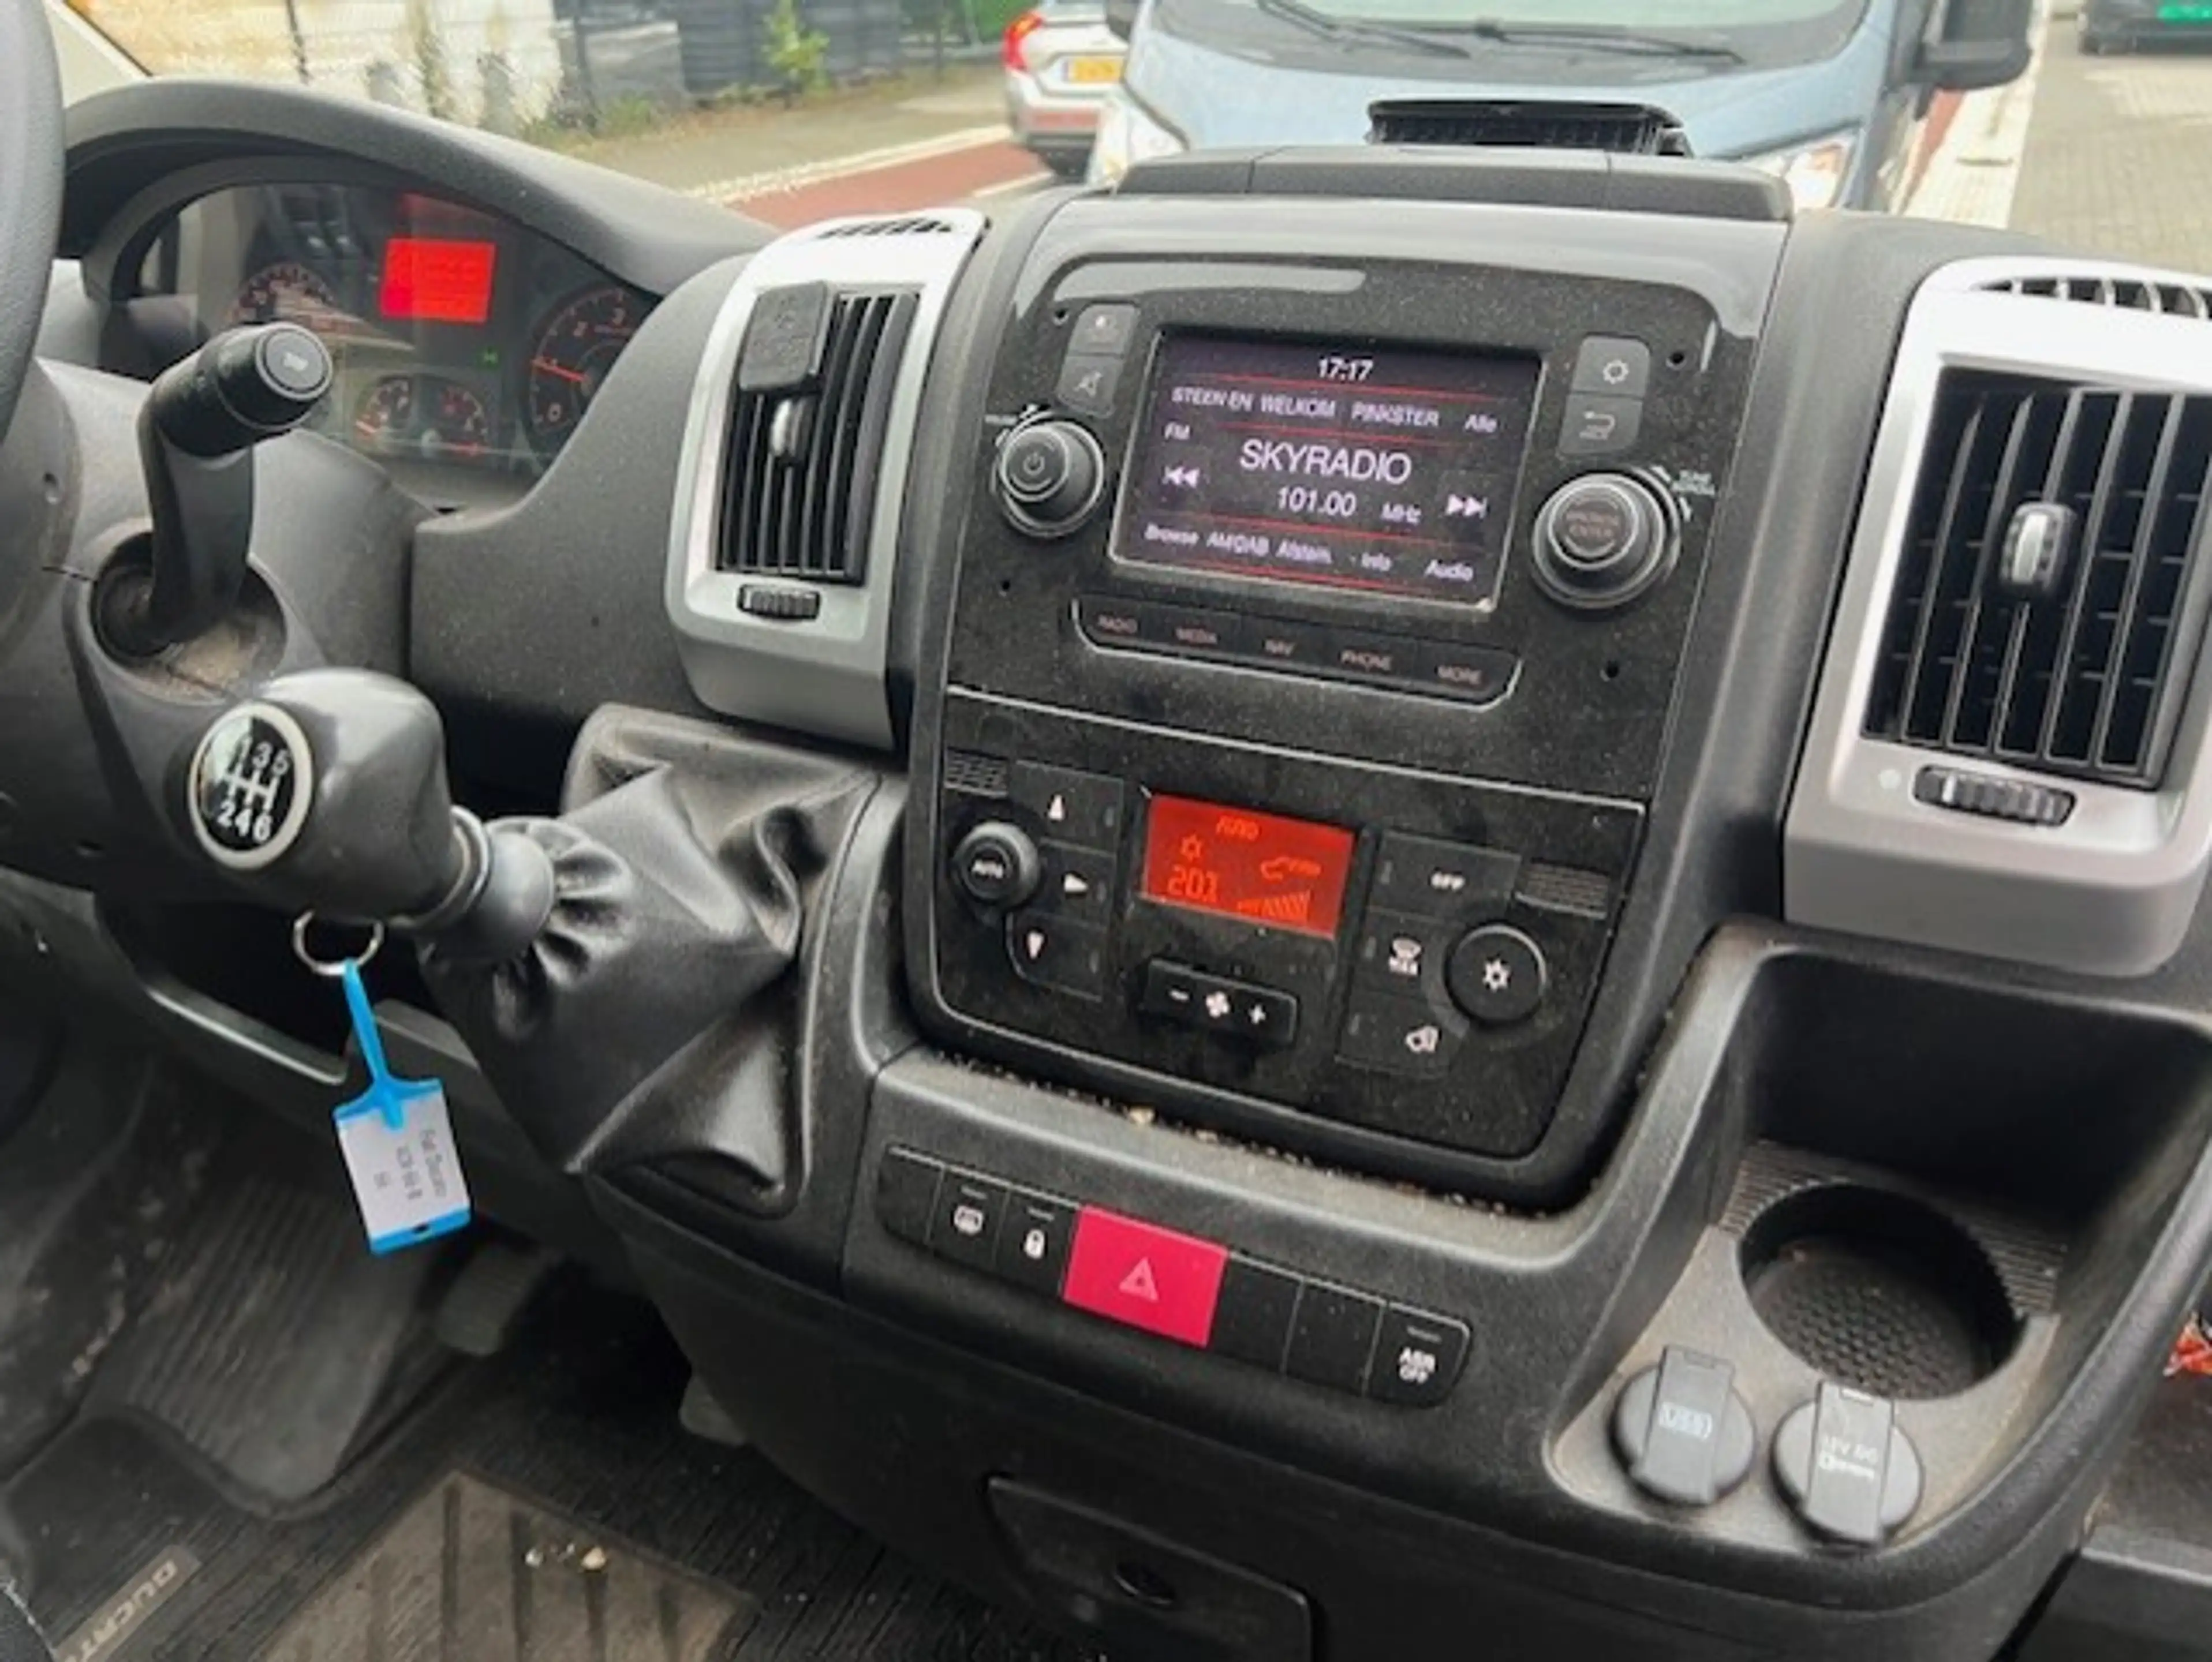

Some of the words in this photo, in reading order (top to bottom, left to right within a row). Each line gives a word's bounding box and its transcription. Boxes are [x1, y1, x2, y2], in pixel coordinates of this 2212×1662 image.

[1318, 356, 1374, 381] 17:17
[1261, 394, 1336, 418] WELKOM
[1351, 401, 1440, 429] PINKSTER
[1164, 421, 1190, 439] FM
[1240, 438, 1413, 485] SKYRADIO
[1277, 485, 1357, 517] 101.00
[1381, 502, 1422, 525] MHz
[1144, 521, 1200, 546] Browse
[1425, 559, 1475, 581] Audio
[1098, 615, 1138, 634] RADIO
[1175, 627, 1217, 645] MEDIA
[1265, 639, 1295, 657] NAV
[1341, 650, 1393, 672] PHONE
[1437, 664, 1482, 685] MORE
[252, 741, 272, 770] 3
[216, 799, 236, 828] 2
[234, 808, 252, 837] 4
[1431, 870, 1466, 890] OFF
[1399, 1346, 1436, 1374] ASR
[1399, 1364, 1430, 1384] OFF
